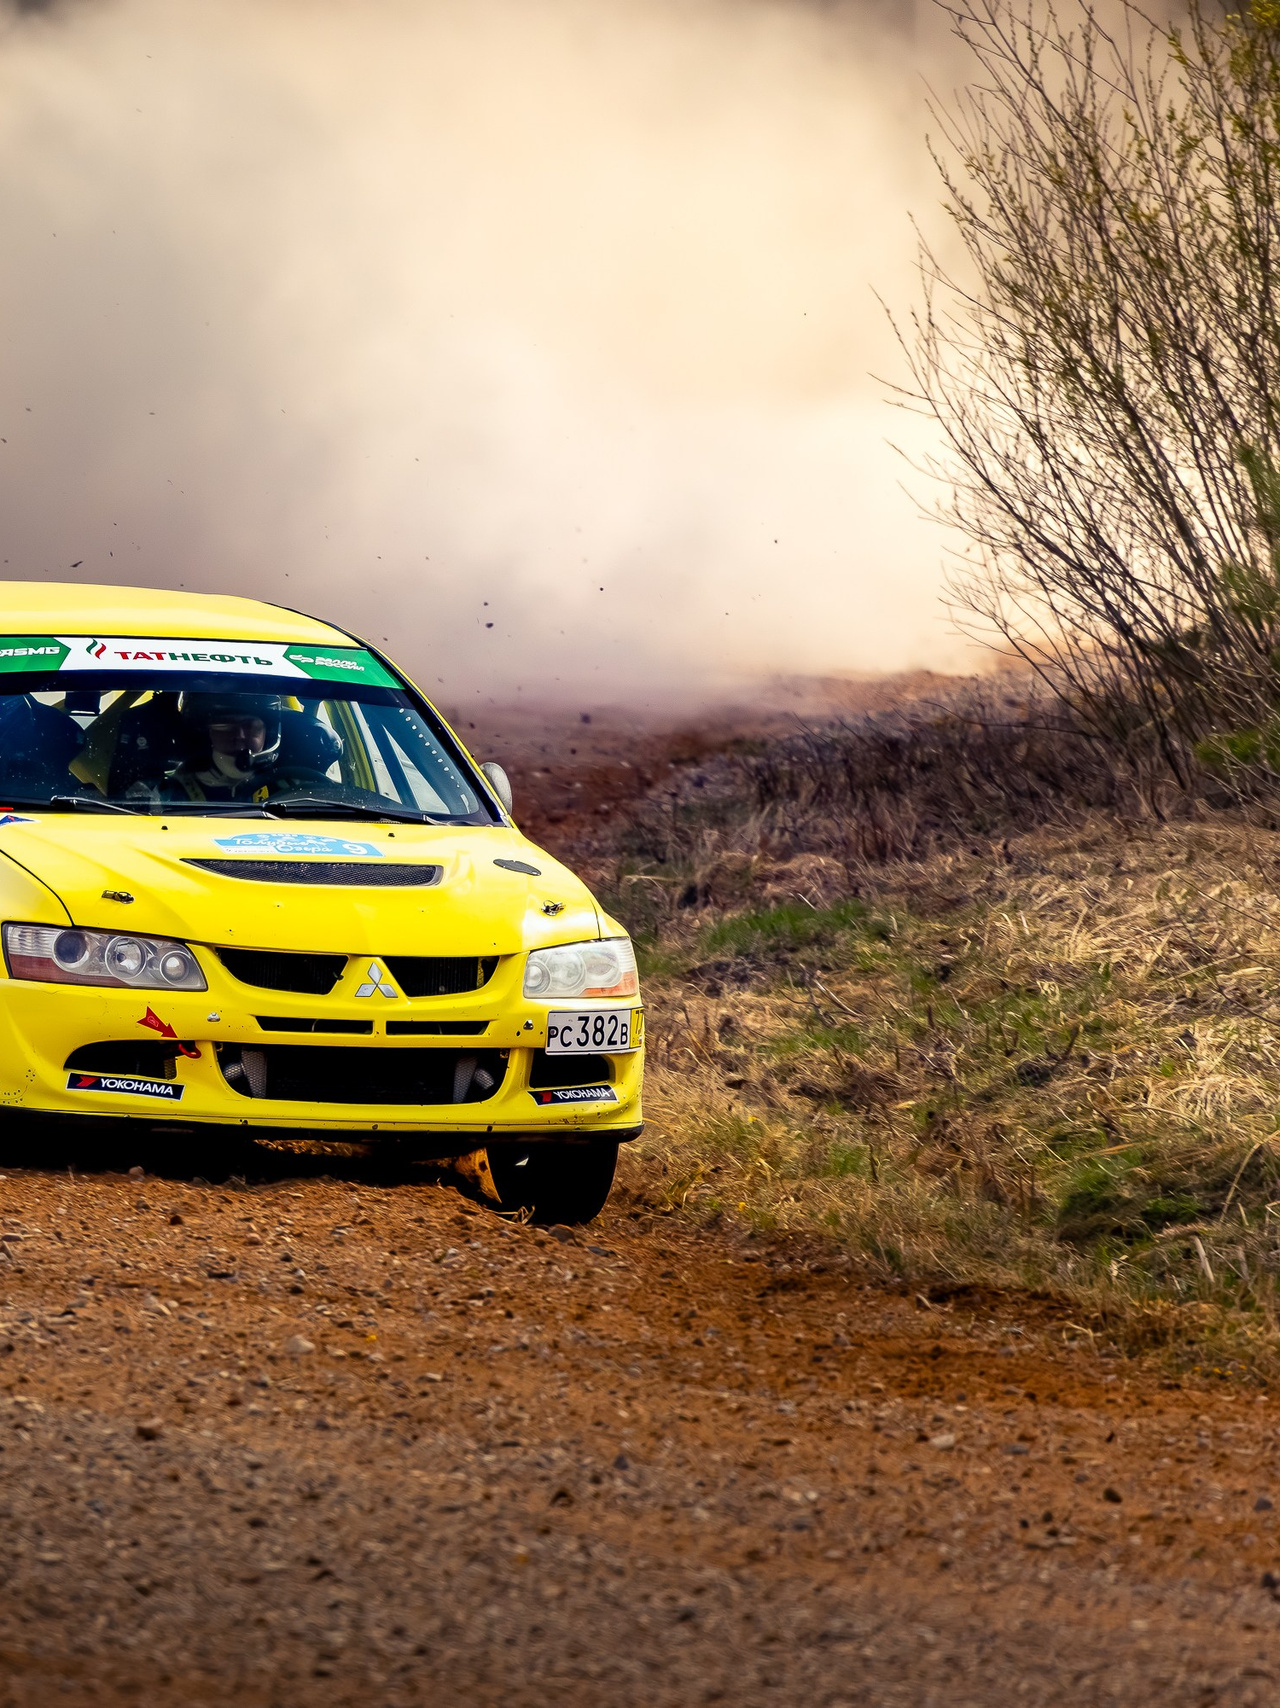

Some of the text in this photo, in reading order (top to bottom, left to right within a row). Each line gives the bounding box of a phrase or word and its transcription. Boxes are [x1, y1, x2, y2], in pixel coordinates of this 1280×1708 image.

[114, 651, 273, 666] ТАТНЕФТЬ
[342, 843, 368, 855] 9
[100, 1078, 174, 1095] YOKOHAMA
[553, 1087, 611, 1099] YOKOHAMA
